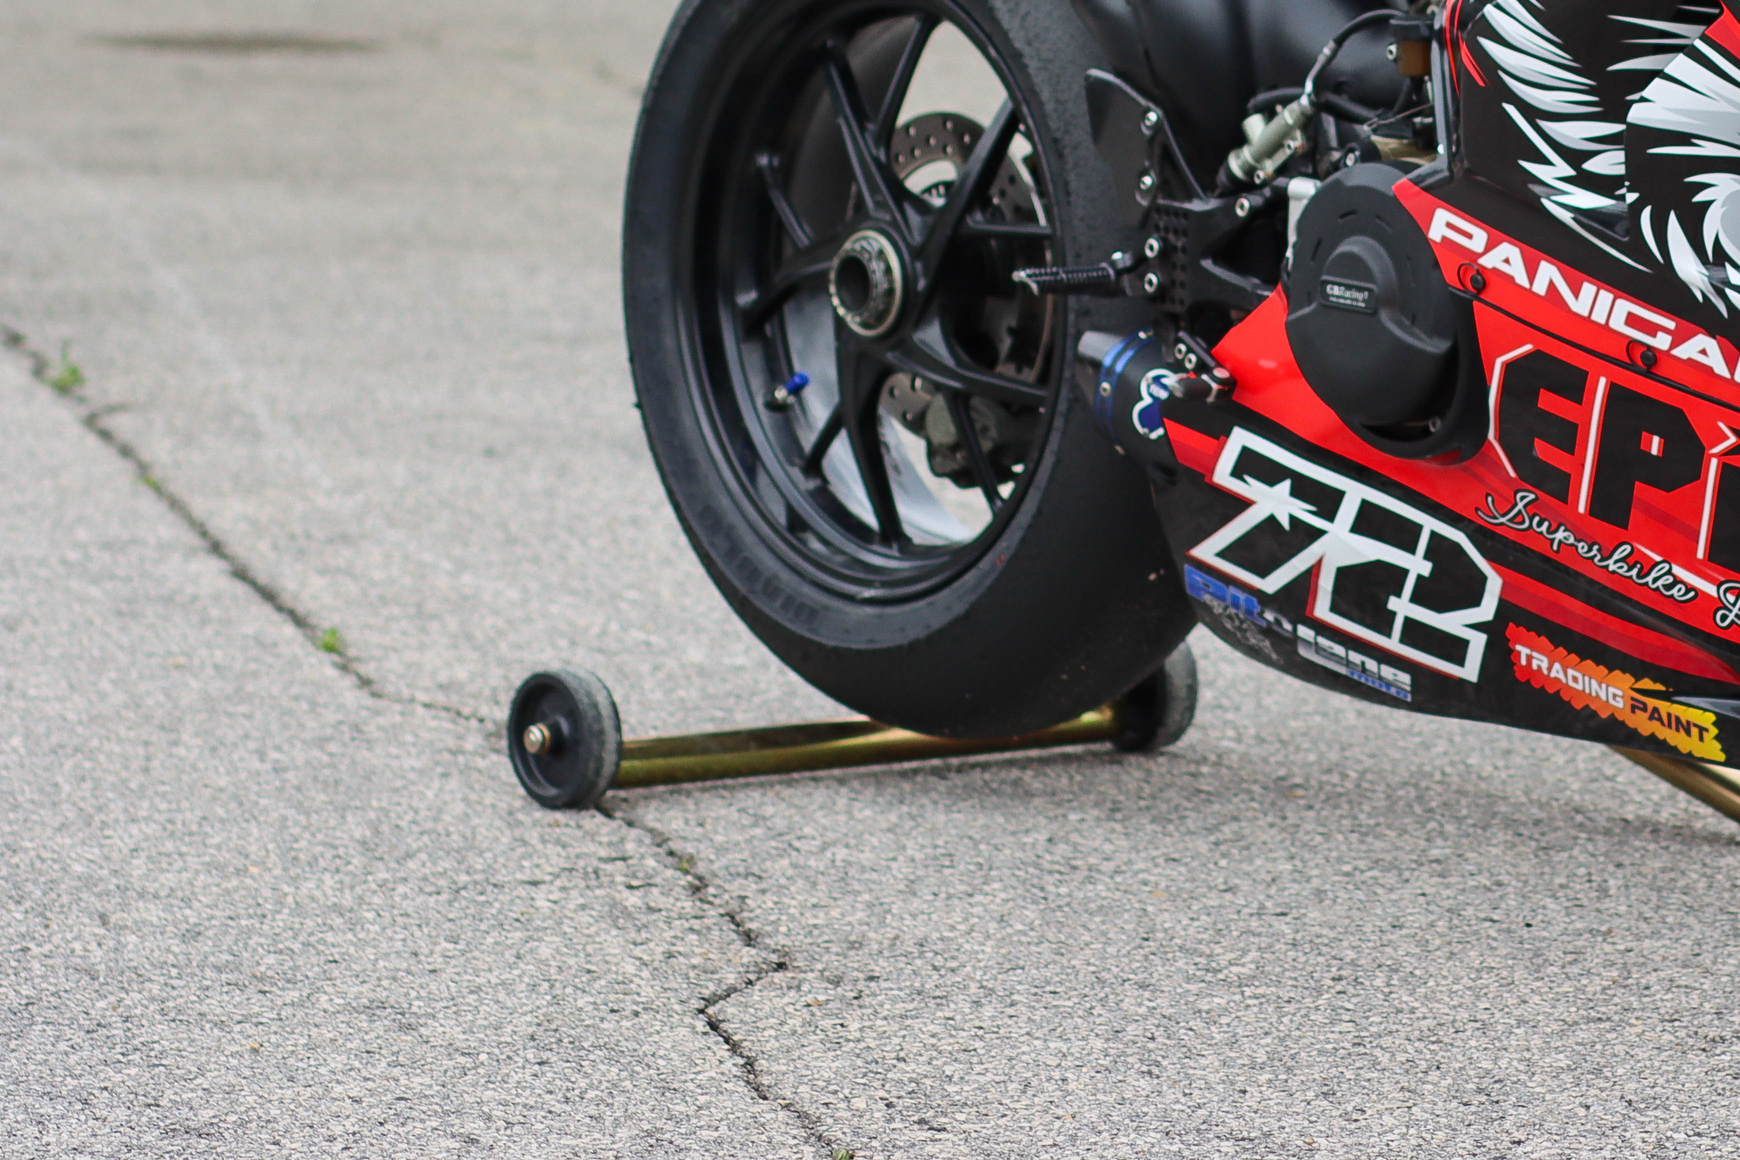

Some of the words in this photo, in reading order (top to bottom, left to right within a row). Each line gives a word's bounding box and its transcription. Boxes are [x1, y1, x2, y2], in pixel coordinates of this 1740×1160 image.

[1188, 425, 1504, 684] 72
[1476, 490, 1698, 604] Superbike
[1515, 644, 1625, 709] TRADING
[1630, 696, 1710, 744] PAINT
